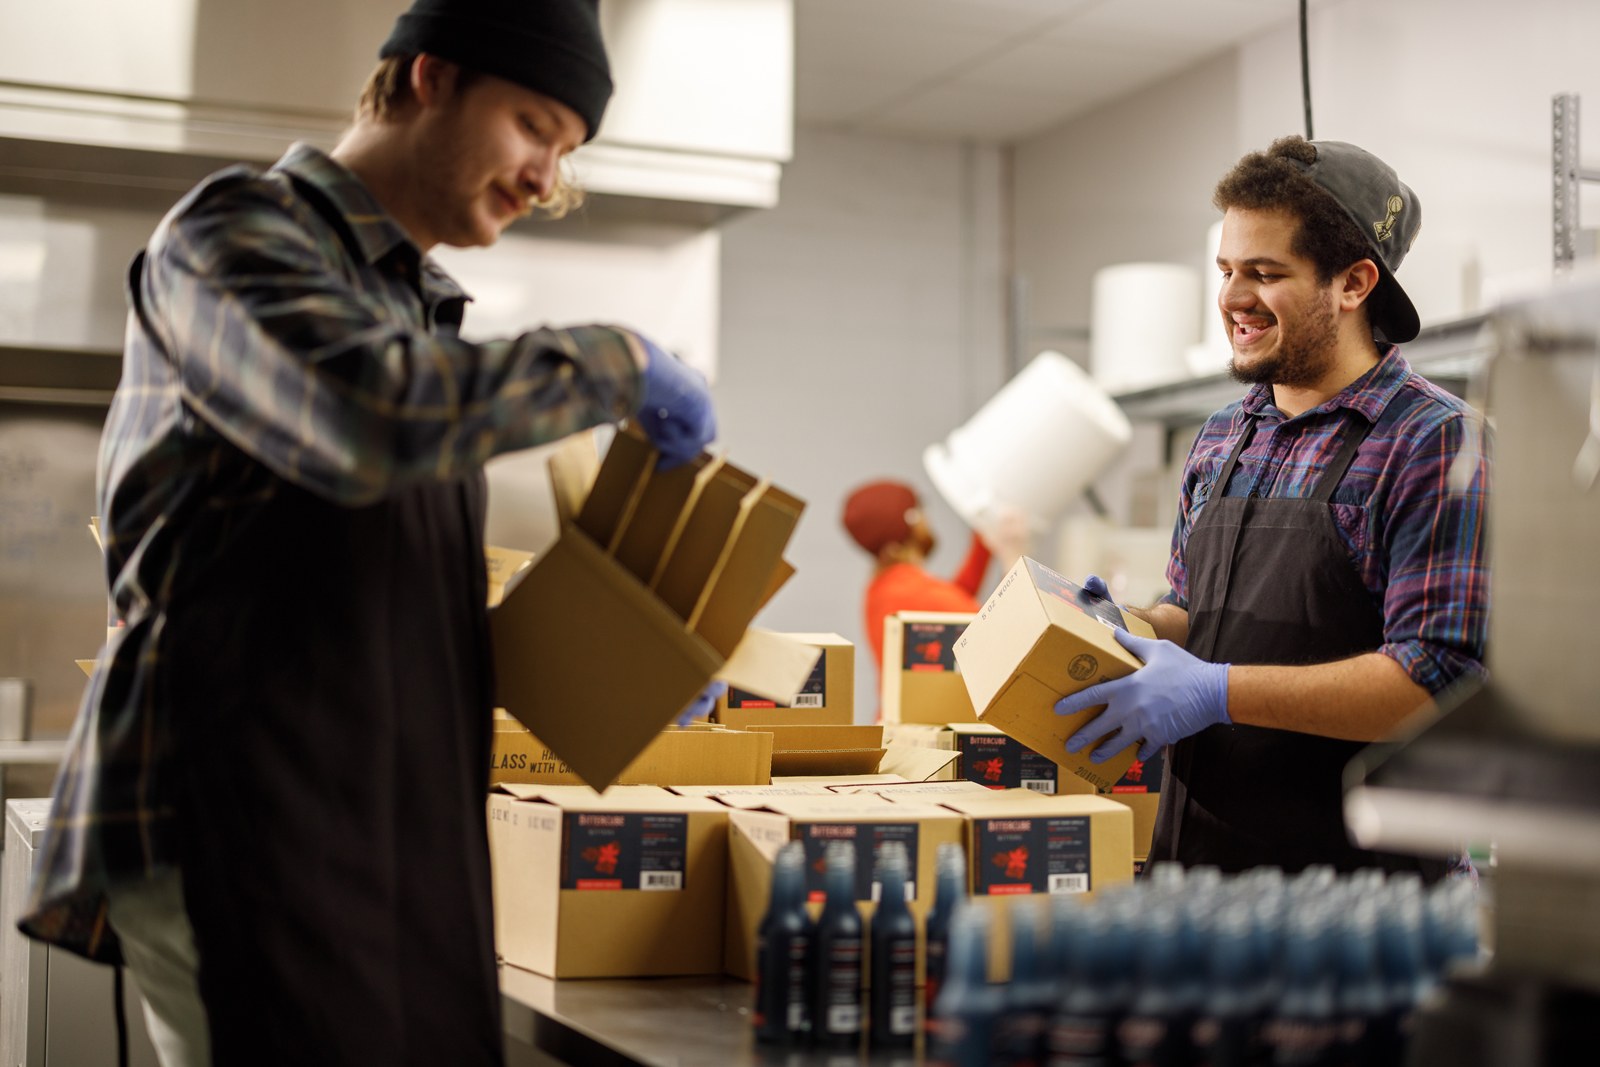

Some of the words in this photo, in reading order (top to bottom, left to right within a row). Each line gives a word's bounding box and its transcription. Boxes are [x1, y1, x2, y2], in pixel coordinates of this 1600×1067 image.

[981, 612, 987, 620] 5
[987, 599, 996, 612] OZ
[997, 570, 1018, 597] WOOZY
[970, 736, 1006, 745] BITTERCUBE
[529, 762, 556, 773] WITH
